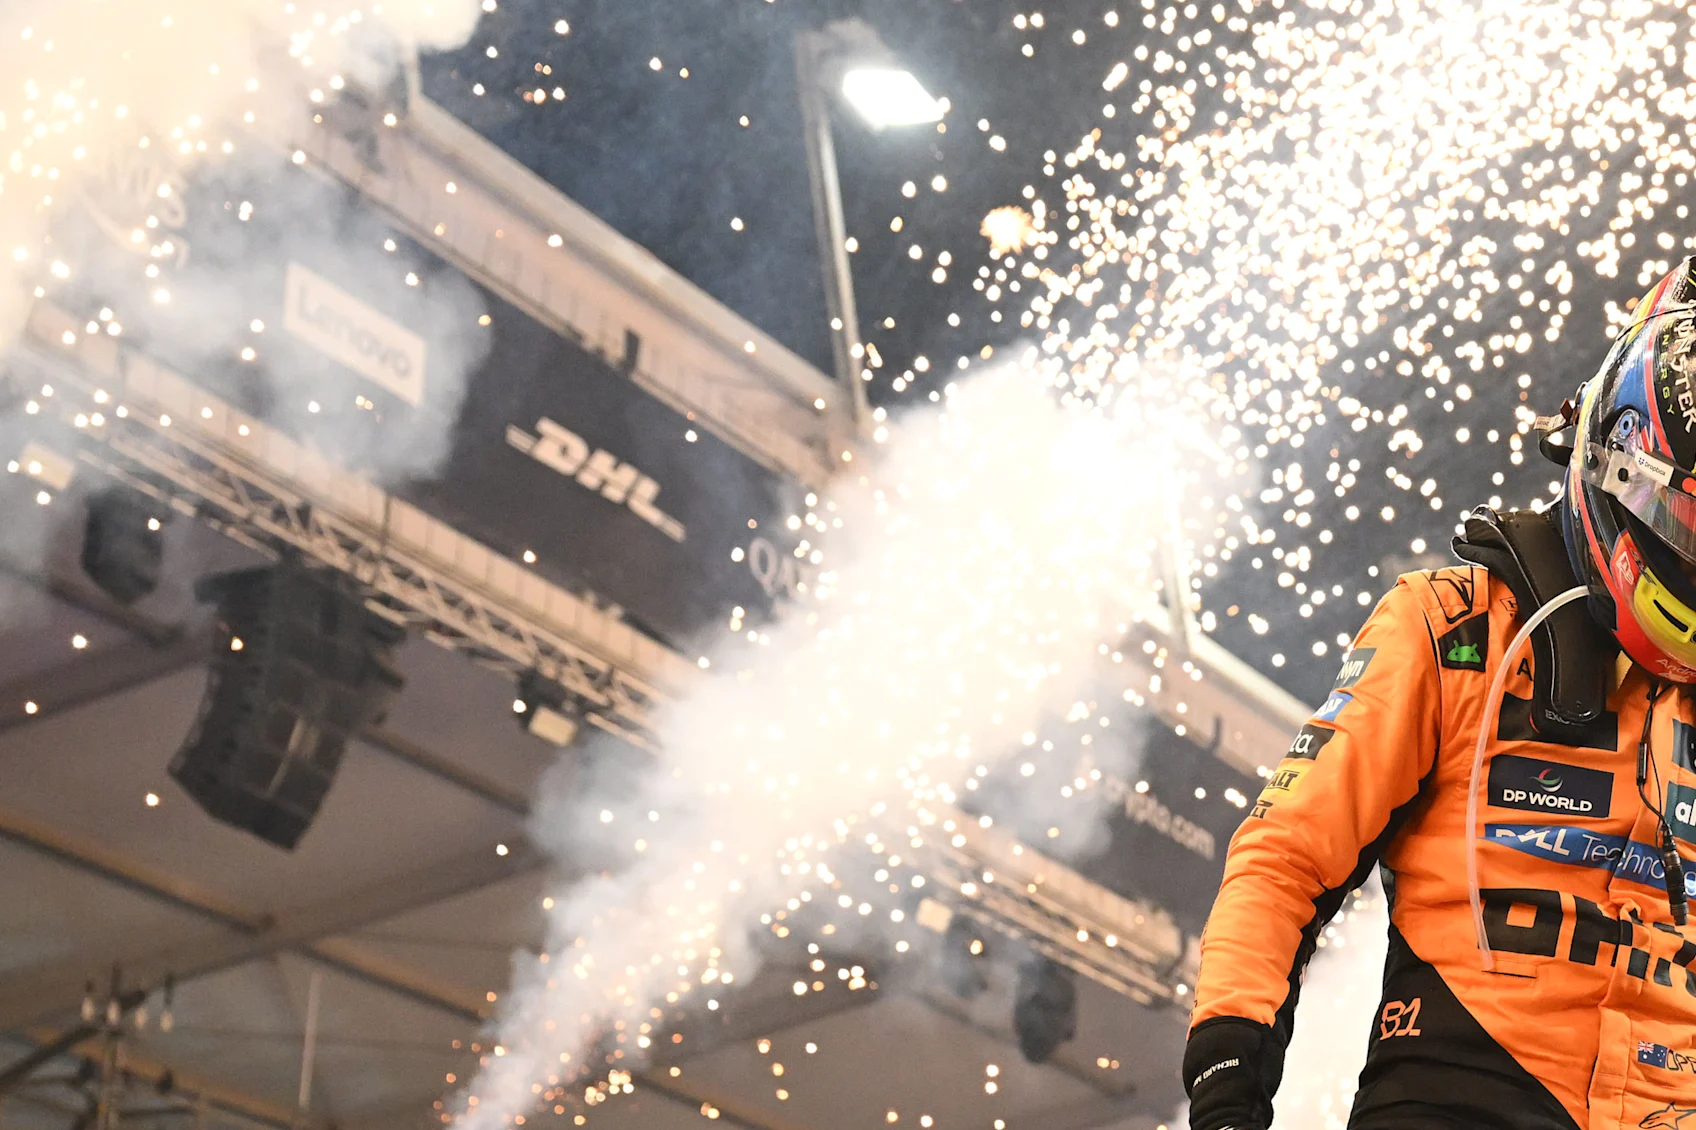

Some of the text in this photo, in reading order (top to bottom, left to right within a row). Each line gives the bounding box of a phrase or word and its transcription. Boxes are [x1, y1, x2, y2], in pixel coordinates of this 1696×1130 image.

[298, 283, 412, 379] Lenovo
[508, 416, 686, 543] DHL
[1644, 461, 1667, 478] Dropbox
[1503, 788, 1593, 813] DP WORLD
[1379, 997, 1422, 1041] 81
[1203, 1057, 1240, 1080] RICHARD
